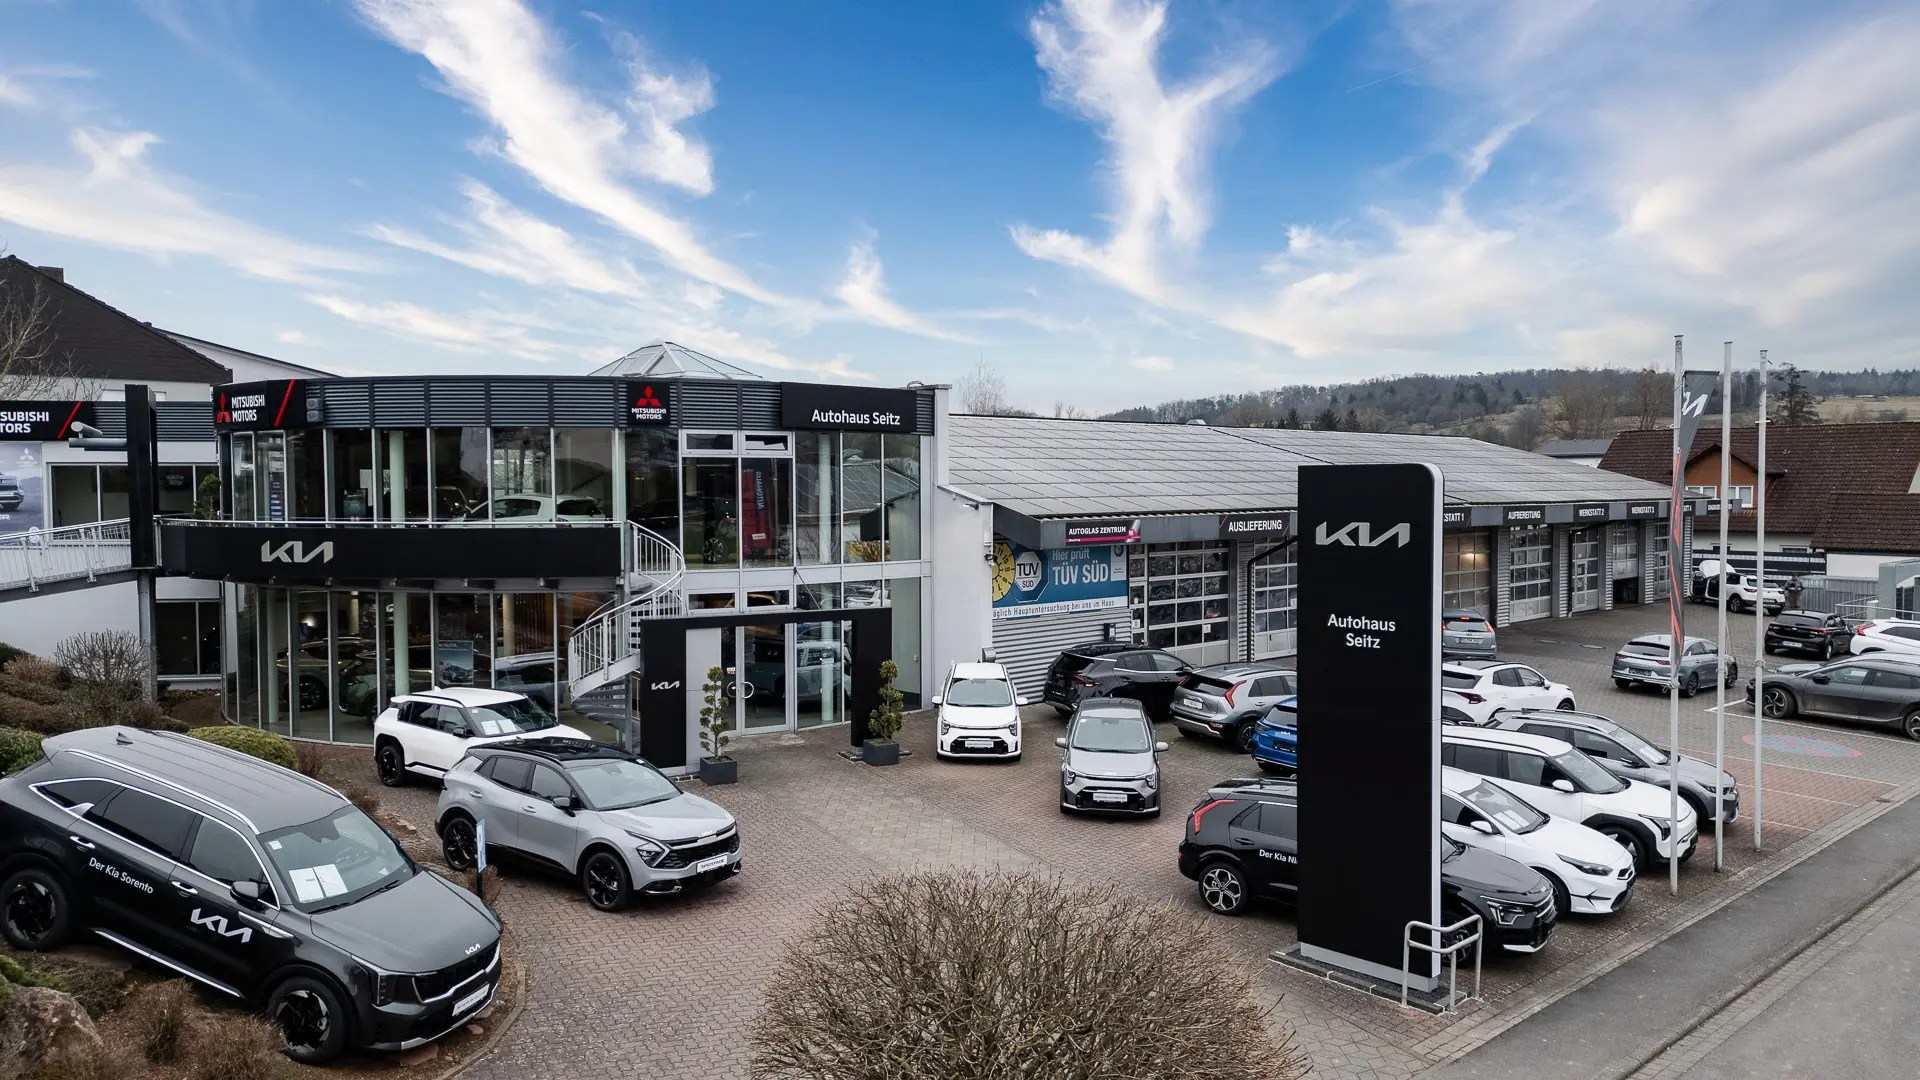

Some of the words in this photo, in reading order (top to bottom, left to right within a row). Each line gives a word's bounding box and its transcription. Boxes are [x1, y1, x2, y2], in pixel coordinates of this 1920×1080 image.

[231, 394, 265, 409] MITSUBISHI
[232, 409, 257, 422] MOTORS
[811, 409, 870, 424] Autohaus
[872, 412, 901, 426] Seitz
[1508, 511, 1541, 520] AUFBEREITUNG
[1068, 527, 1099, 536] AUTOGLAS
[1100, 526, 1126, 534] ZENTRUM
[1228, 519, 1282, 533] AUSLIEFERUNG
[1316, 521, 1410, 548] KIA
[261, 540, 334, 564] KIA
[1052, 550, 1069, 561] Hier
[1070, 548, 1090, 562] prüft
[1017, 562, 1040, 577] TÜV
[1052, 561, 1079, 585] TÜV
[1082, 560, 1109, 584] SÜD
[1013, 604, 1070, 616] Hauptuntersuchung
[1071, 602, 1080, 611] bei
[1327, 613, 1396, 632] Autohaus
[1346, 633, 1381, 648] Seitz
[651, 680, 680, 690] KIA
[1259, 848, 1273, 859] Der
[1274, 852, 1287, 862] Kia
[1288, 855, 1298, 865] Ni
[89, 857, 105, 872] Der
[105, 864, 119, 879] Kia
[120, 871, 154, 895] Sorento
[190, 907, 253, 944] KIA
